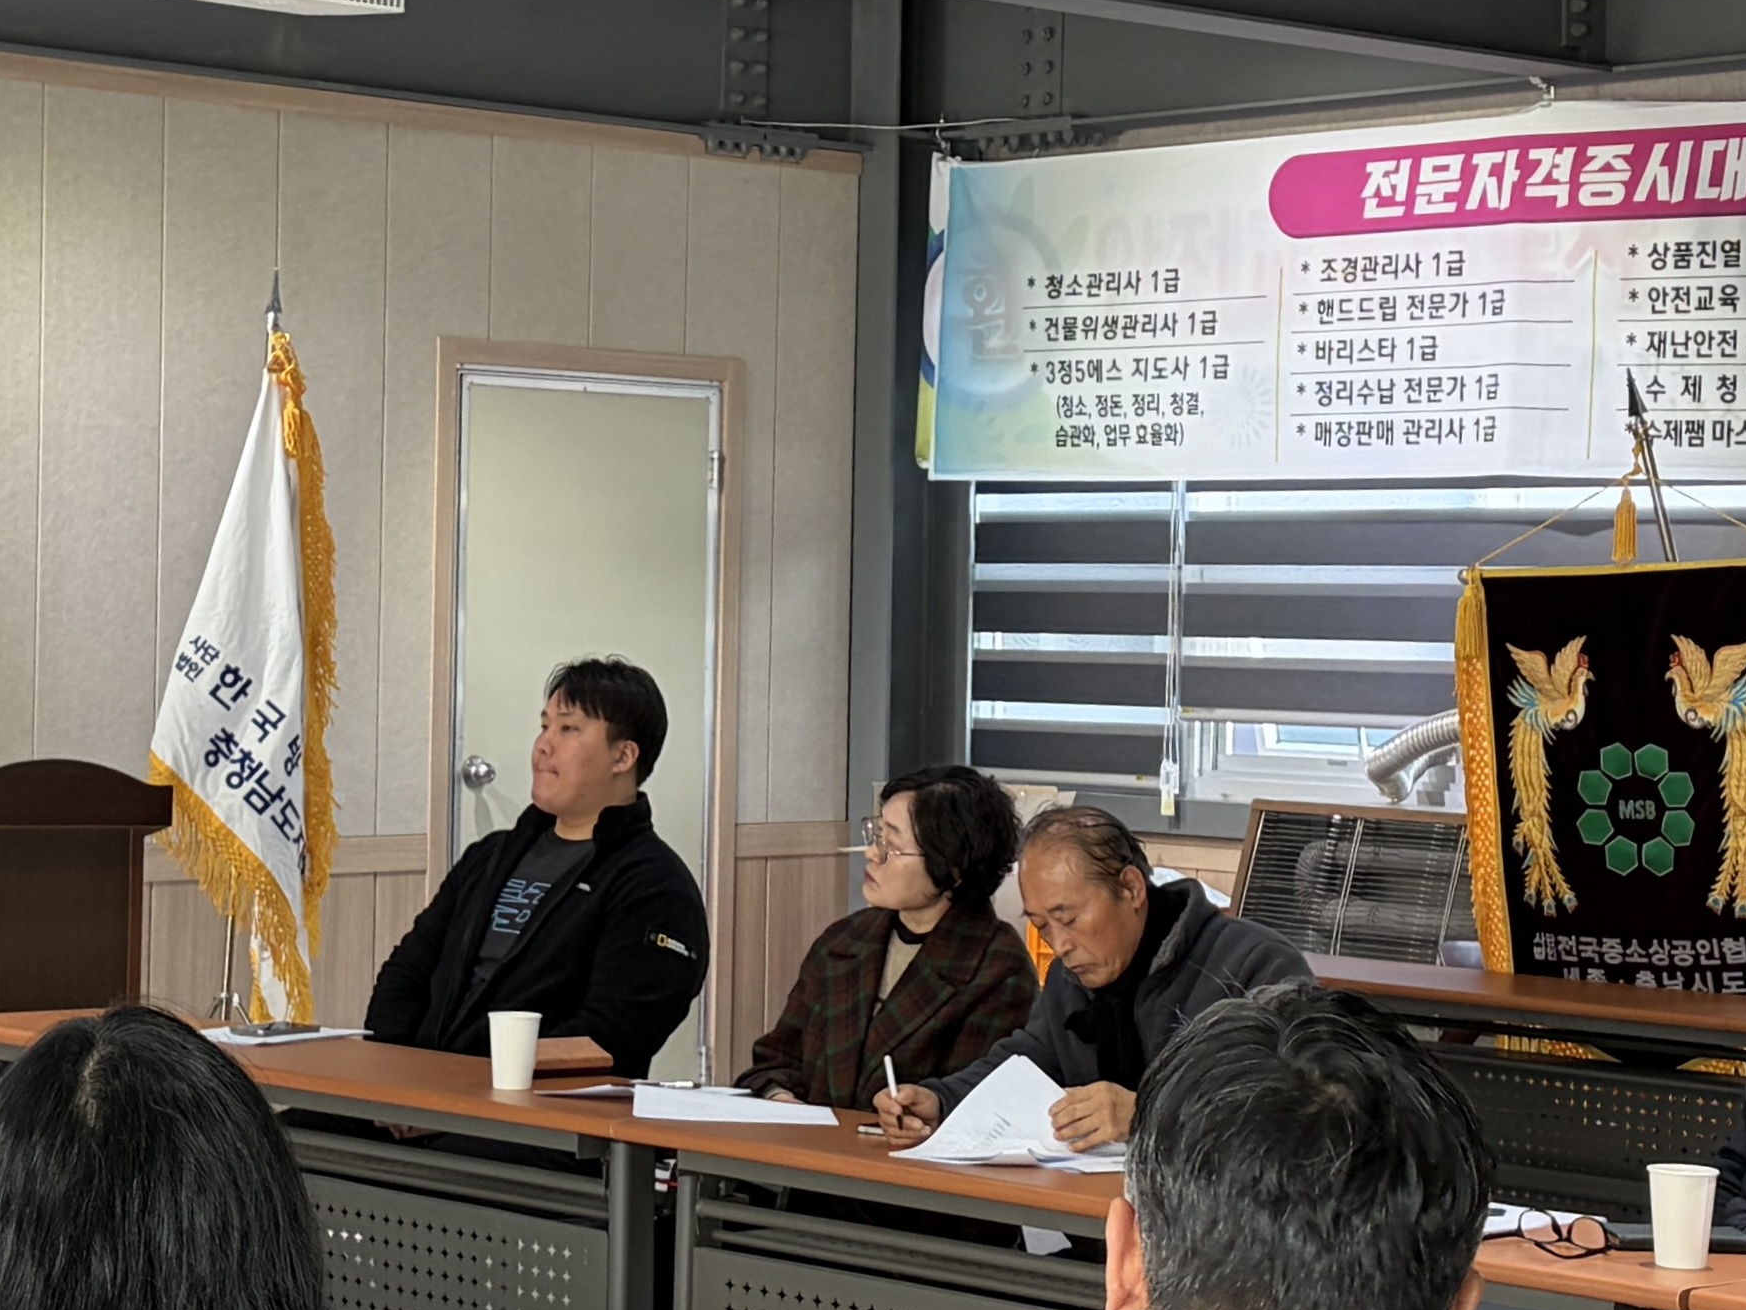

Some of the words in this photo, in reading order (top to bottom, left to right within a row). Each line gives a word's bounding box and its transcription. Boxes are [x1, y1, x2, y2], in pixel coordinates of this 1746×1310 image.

[1319, 255, 1423, 283] 조경관리사
[1431, 250, 1466, 278] 1급
[1647, 237, 1744, 269] 상품진열
[1044, 269, 1143, 299] 청소관리사
[1150, 267, 1180, 294] 1급
[1647, 283, 1741, 315] 안전교육
[1317, 296, 1399, 325] 핸드드립
[1406, 293, 1470, 320] 전문가
[1477, 289, 1506, 316] 1급
[1043, 315, 1179, 344] 건물위생관리사
[1187, 309, 1218, 337] 1급
[1314, 336, 1398, 364] 바리스타
[1407, 335, 1439, 362] 1급
[1645, 329, 1740, 361] 재난안전
[1046, 356, 1124, 385] 3정5에스
[1131, 355, 1191, 382] 지도사
[1199, 353, 1230, 380] 1급
[1055, 392, 1091, 421] (청소,
[1094, 392, 1128, 421] 정돈,
[1131, 392, 1167, 420] 정리,
[1170, 391, 1205, 419] 청결,
[1314, 377, 1399, 408] 정리수납
[1405, 375, 1469, 404] 전문가
[1475, 373, 1501, 401] 1급
[1104, 422, 1133, 448] 업무
[1314, 418, 1396, 448] 매장판매
[1403, 417, 1466, 445] 관리사
[1473, 415, 1497, 442] 1급
[1618, 799, 1657, 821] MSB
